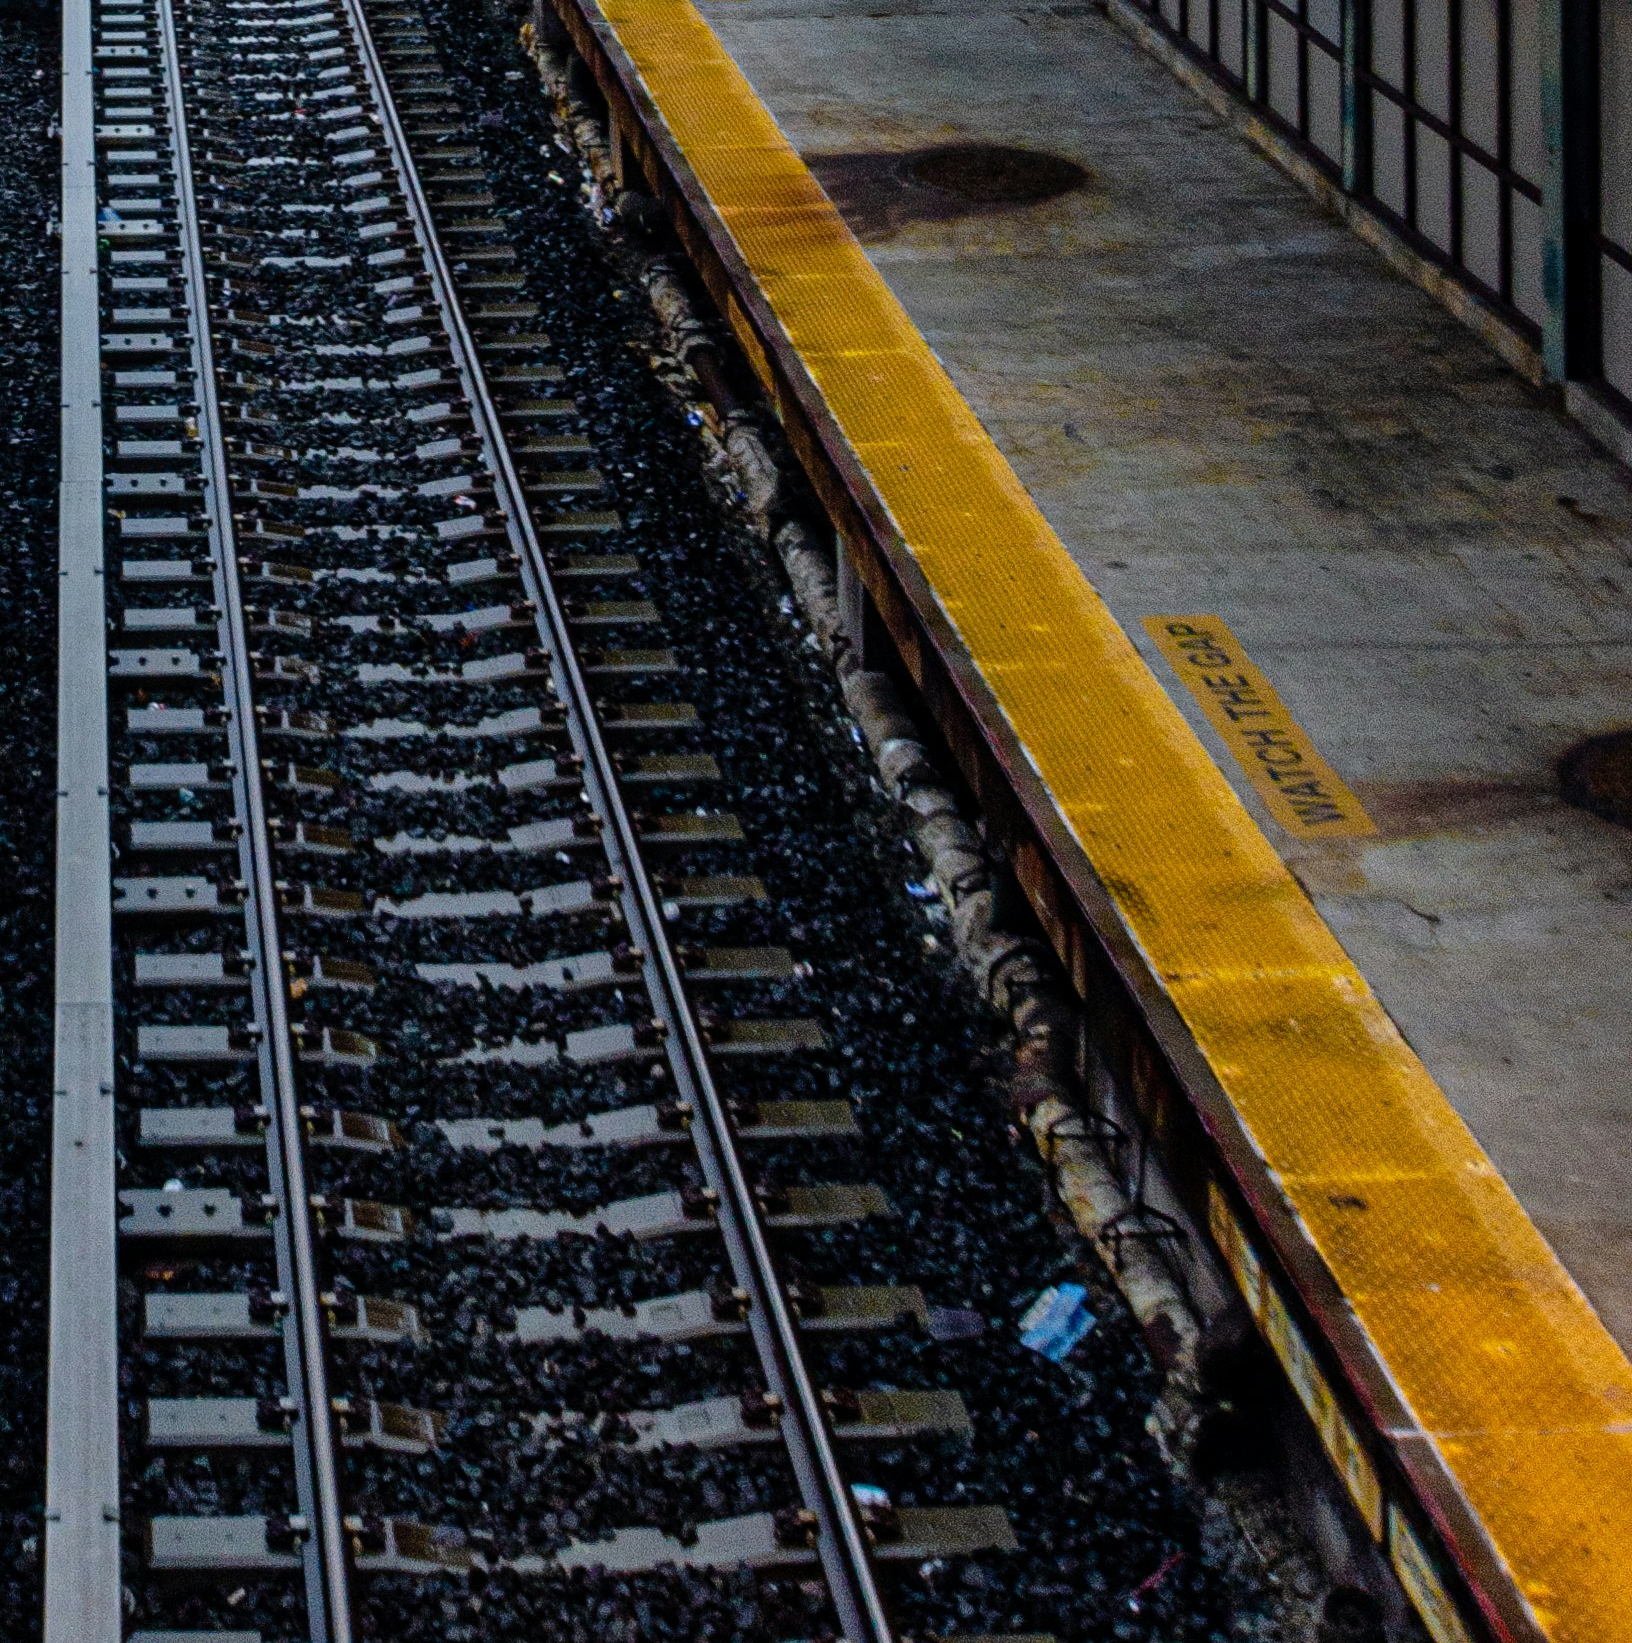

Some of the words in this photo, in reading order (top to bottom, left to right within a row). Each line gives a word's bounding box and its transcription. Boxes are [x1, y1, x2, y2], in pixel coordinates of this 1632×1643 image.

[1165, 623, 1232, 667] GAP
[1201, 674, 1272, 722] THE
[1240, 728, 1346, 827] WATCH
